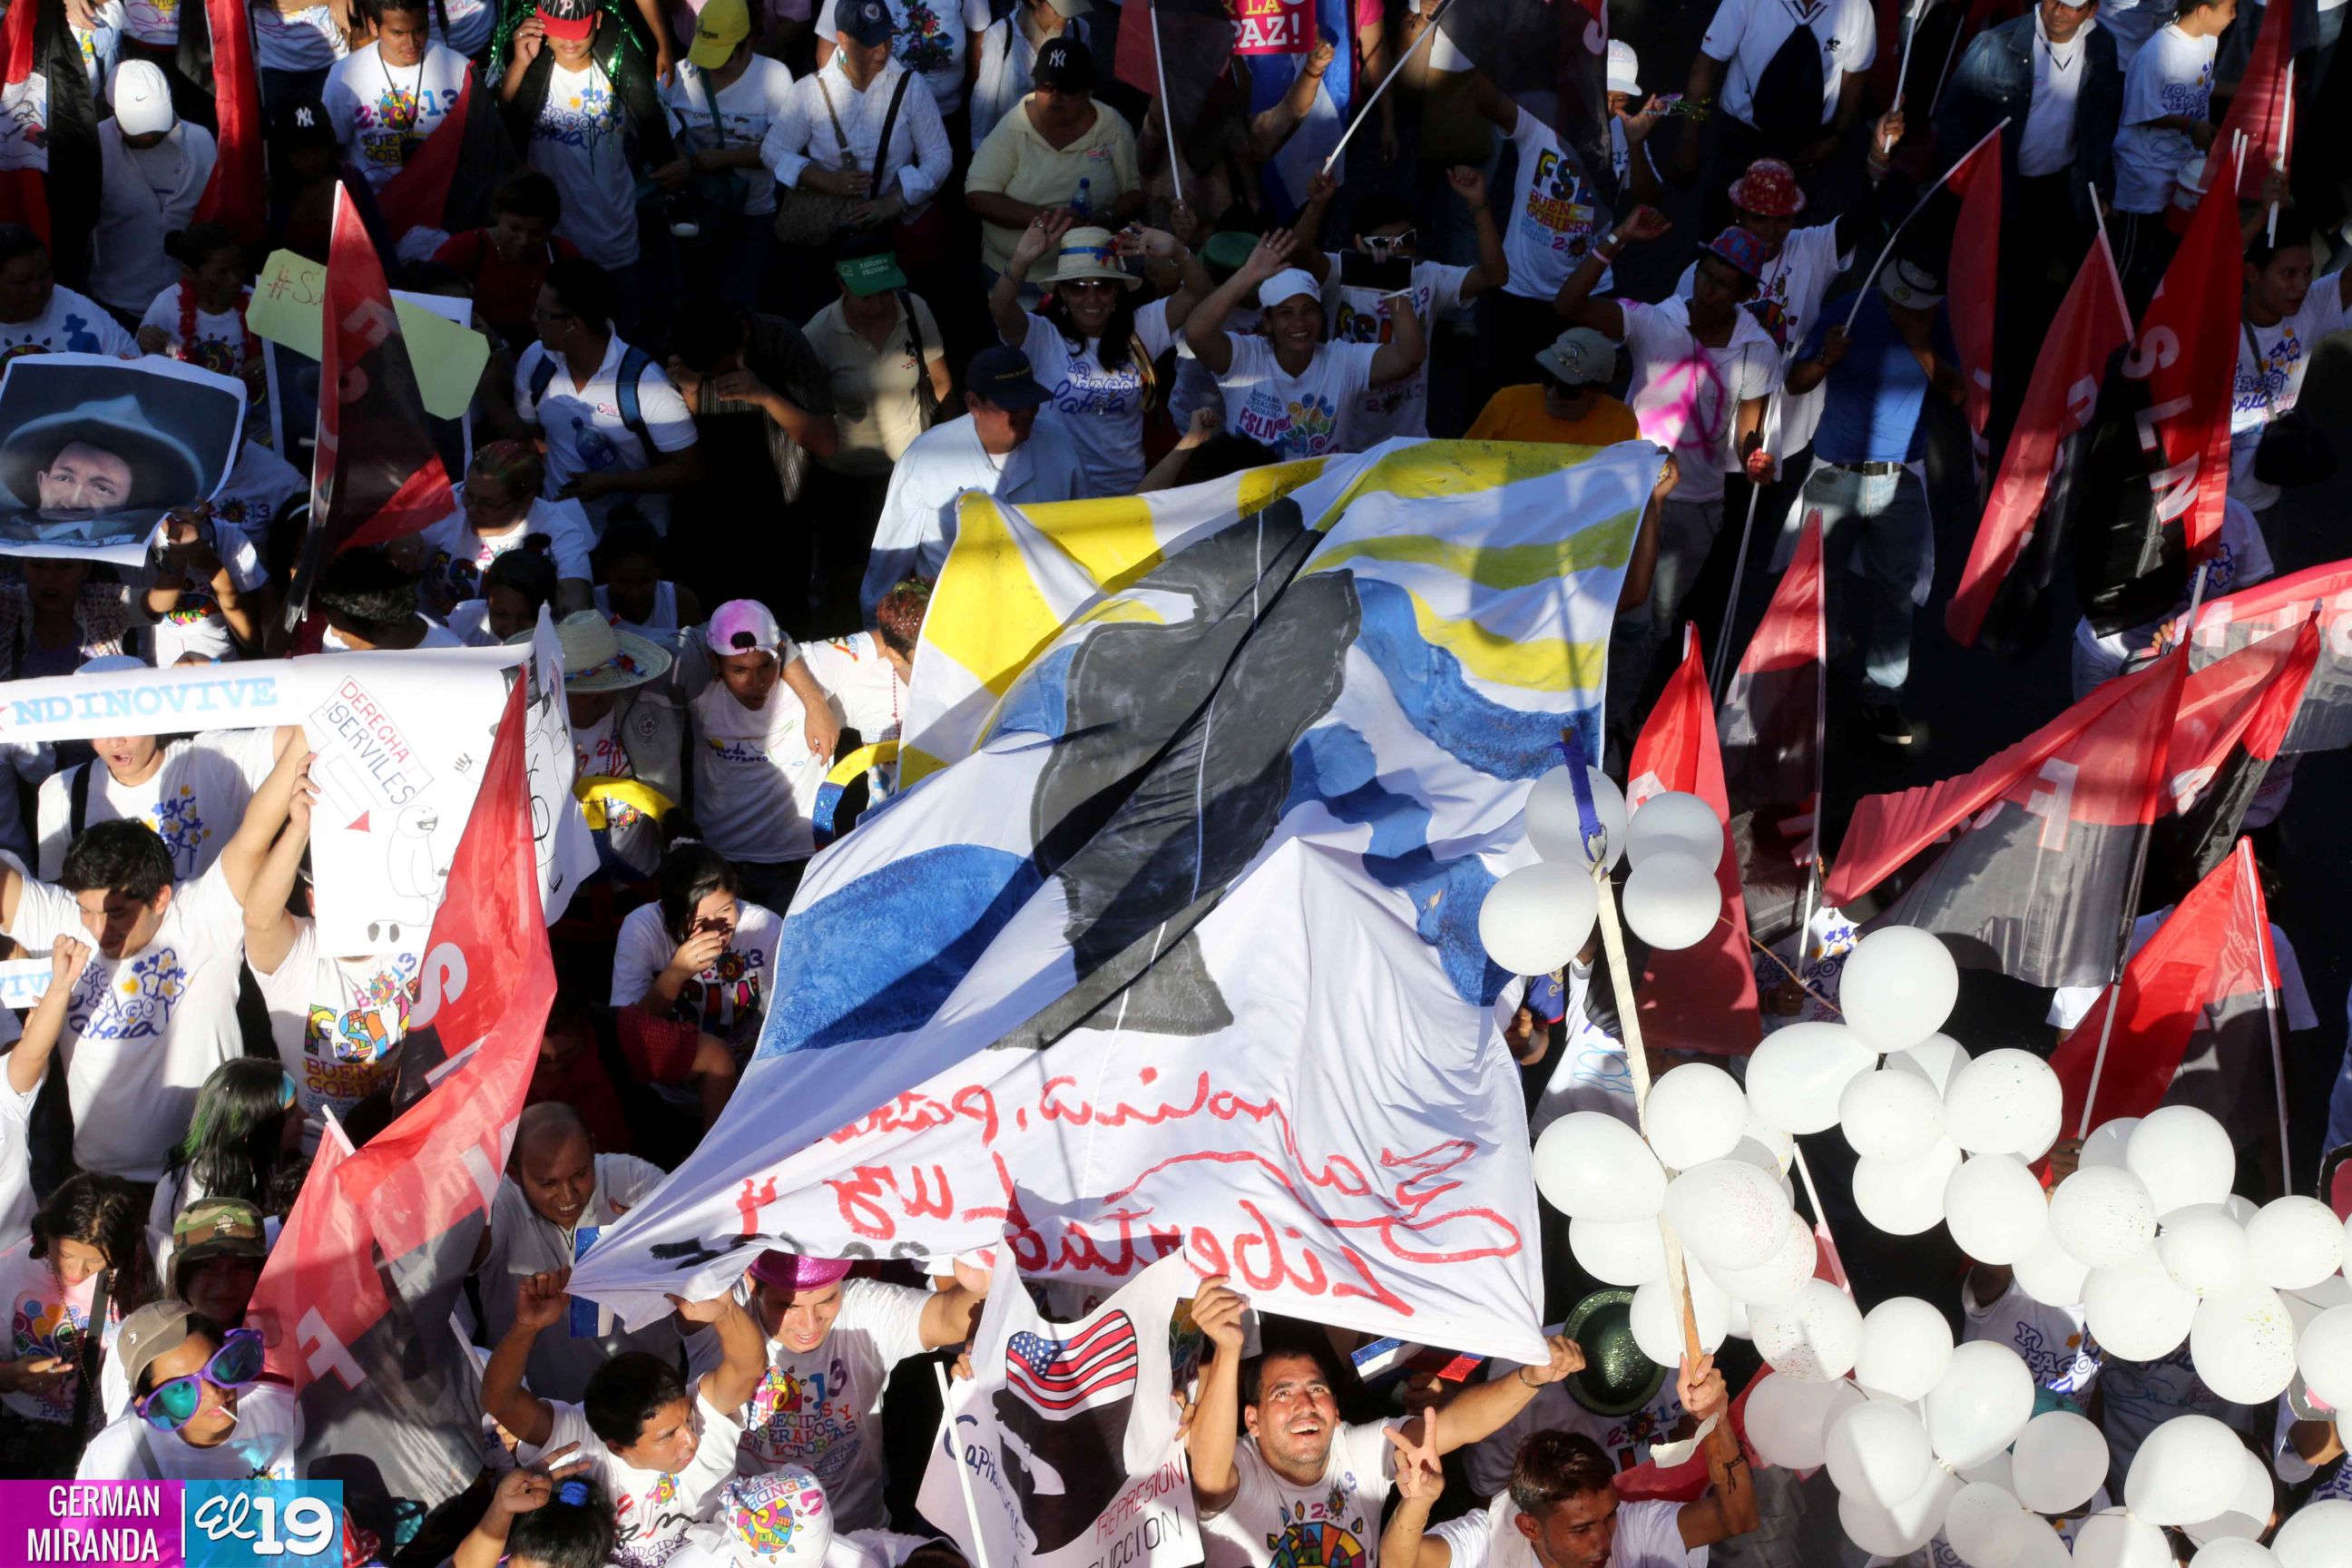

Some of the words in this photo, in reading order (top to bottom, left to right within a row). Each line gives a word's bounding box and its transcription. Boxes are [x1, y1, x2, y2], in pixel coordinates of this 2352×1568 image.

[1245, 0, 1282, 15] LA
[1049, 48, 1068, 68] NY
[295, 106, 316, 128] NY
[1526, 202, 1594, 233] GOBIERN
[1240, 407, 1279, 441] FSLN
[339, 681, 410, 764] DERECHA
[304, 1055, 376, 1079] BUEN
[1096, 1453, 1185, 1545] REPRESION
